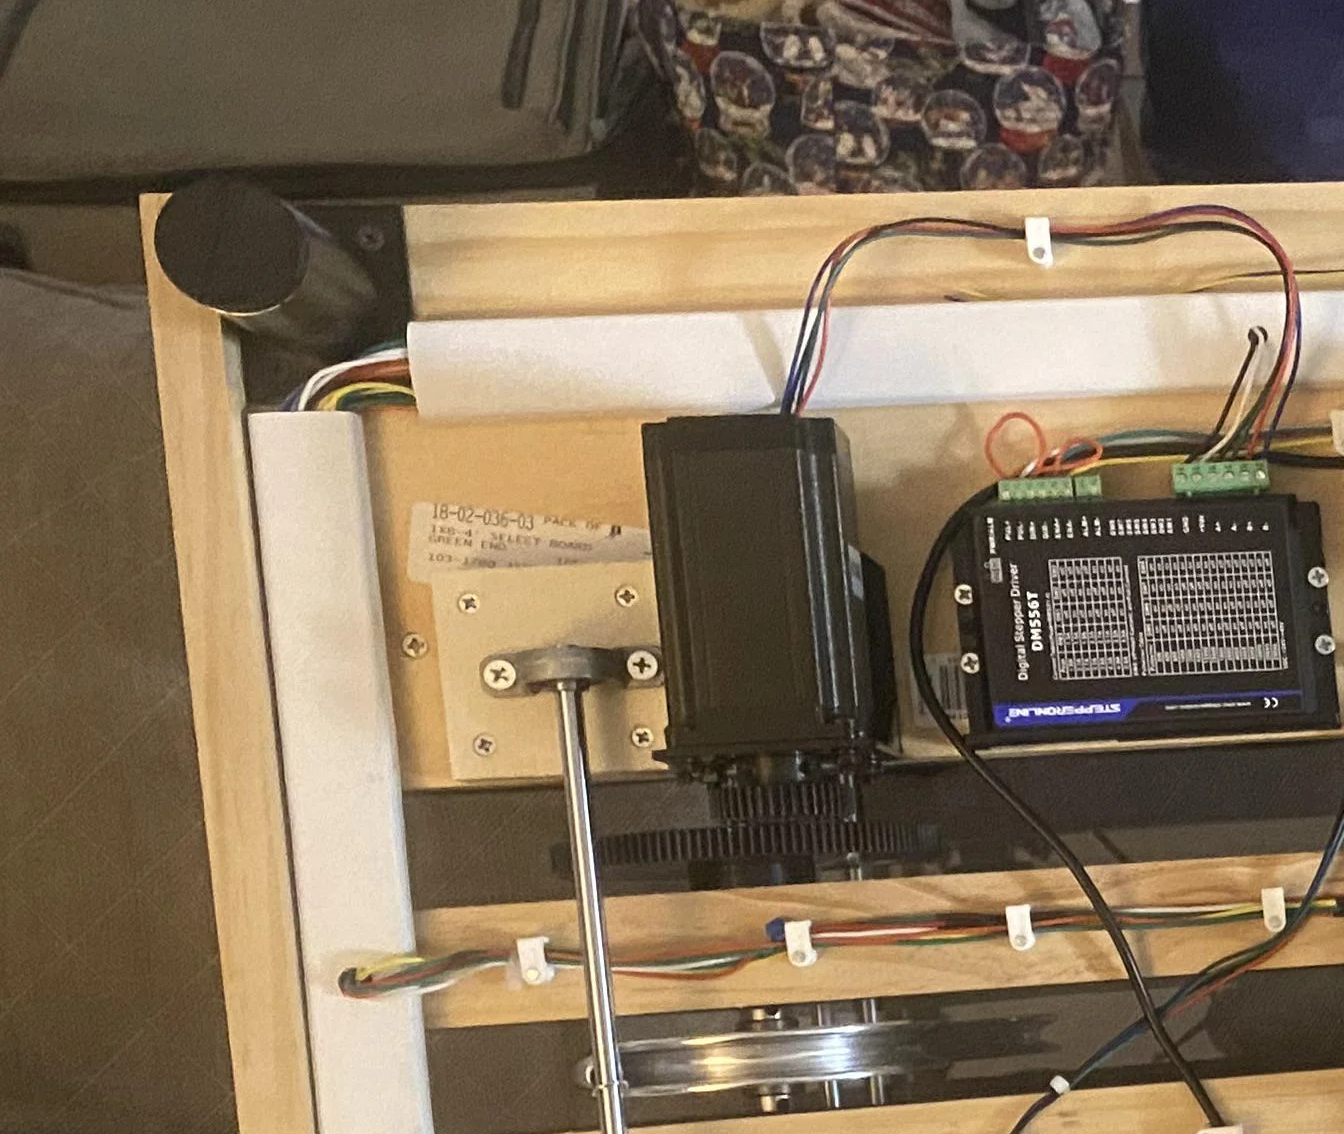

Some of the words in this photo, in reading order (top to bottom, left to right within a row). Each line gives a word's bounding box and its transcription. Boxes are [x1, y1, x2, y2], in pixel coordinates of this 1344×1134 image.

[431, 503, 535, 531] 18-02-036-03
[1009, 562, 1022, 598] Driver
[1012, 600, 1026, 643] Stepper
[1026, 590, 1045, 652] DM556T
[1016, 644, 1031, 682] Digital
[1008, 702, 1121, 718] STEPPERONLINE
